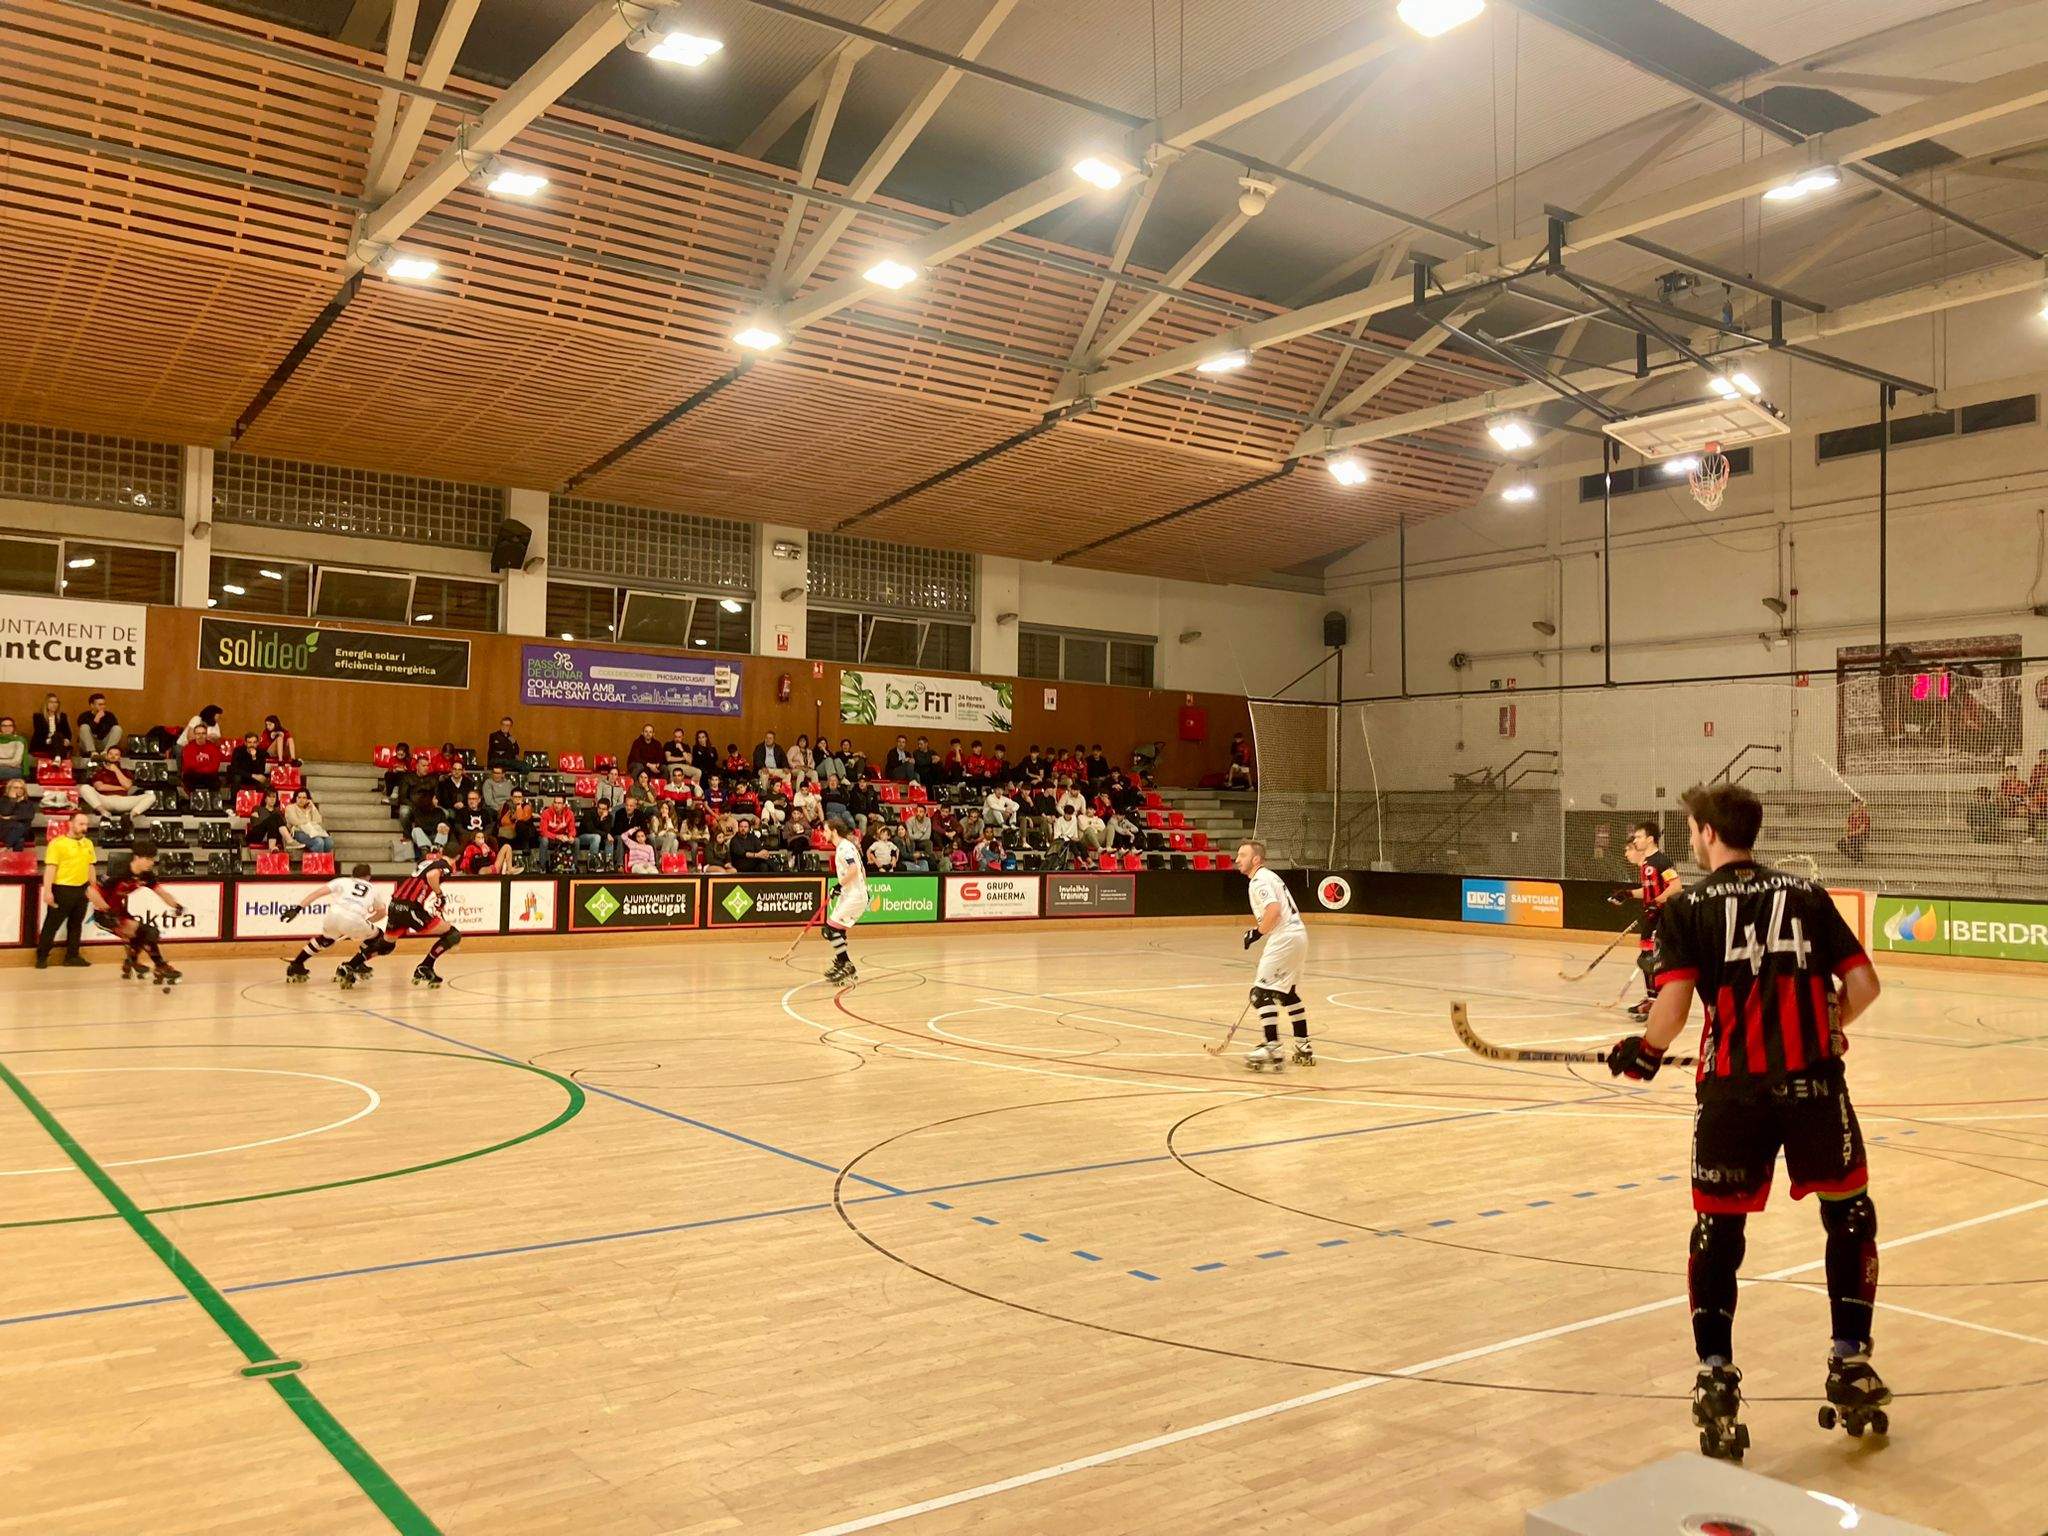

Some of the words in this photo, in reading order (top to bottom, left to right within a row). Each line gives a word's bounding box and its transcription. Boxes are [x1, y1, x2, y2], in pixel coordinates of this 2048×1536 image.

[113, 626, 138, 642] DE
[0, 639, 137, 670] ntCugat
[219, 629, 309, 671] solideo
[335, 648, 373, 660] Energia
[375, 651, 400, 661] solar
[334, 659, 383, 671] eficiència
[385, 664, 436, 675] energètica
[528, 668, 542, 678] DE
[544, 669, 583, 680] CUINAR
[592, 682, 615, 693] AMB
[528, 688, 540, 698] EL
[541, 688, 563, 699] PHC
[565, 690, 591, 701] SANT
[592, 692, 627, 703] CUGAT
[924, 691, 952, 713] FiT
[351, 883, 369, 898] 9
[986, 882, 1014, 890] GRUPO
[623, 894, 676, 904] AJUNTAMENT
[676, 893, 687, 902] DE
[756, 892, 804, 901] AJUNTAMENT
[804, 892, 813, 900] DE
[986, 892, 1026, 901] GAHERMA
[1060, 892, 1089, 902] training
[1510, 894, 1560, 906] SANTCUGAT
[622, 902, 686, 917] SantCugat
[756, 900, 813, 914] SantCugat
[882, 897, 933, 911] Iberdrola
[1724, 889, 1812, 976] 44
[1943, 919, 2048, 947] IBERDR
